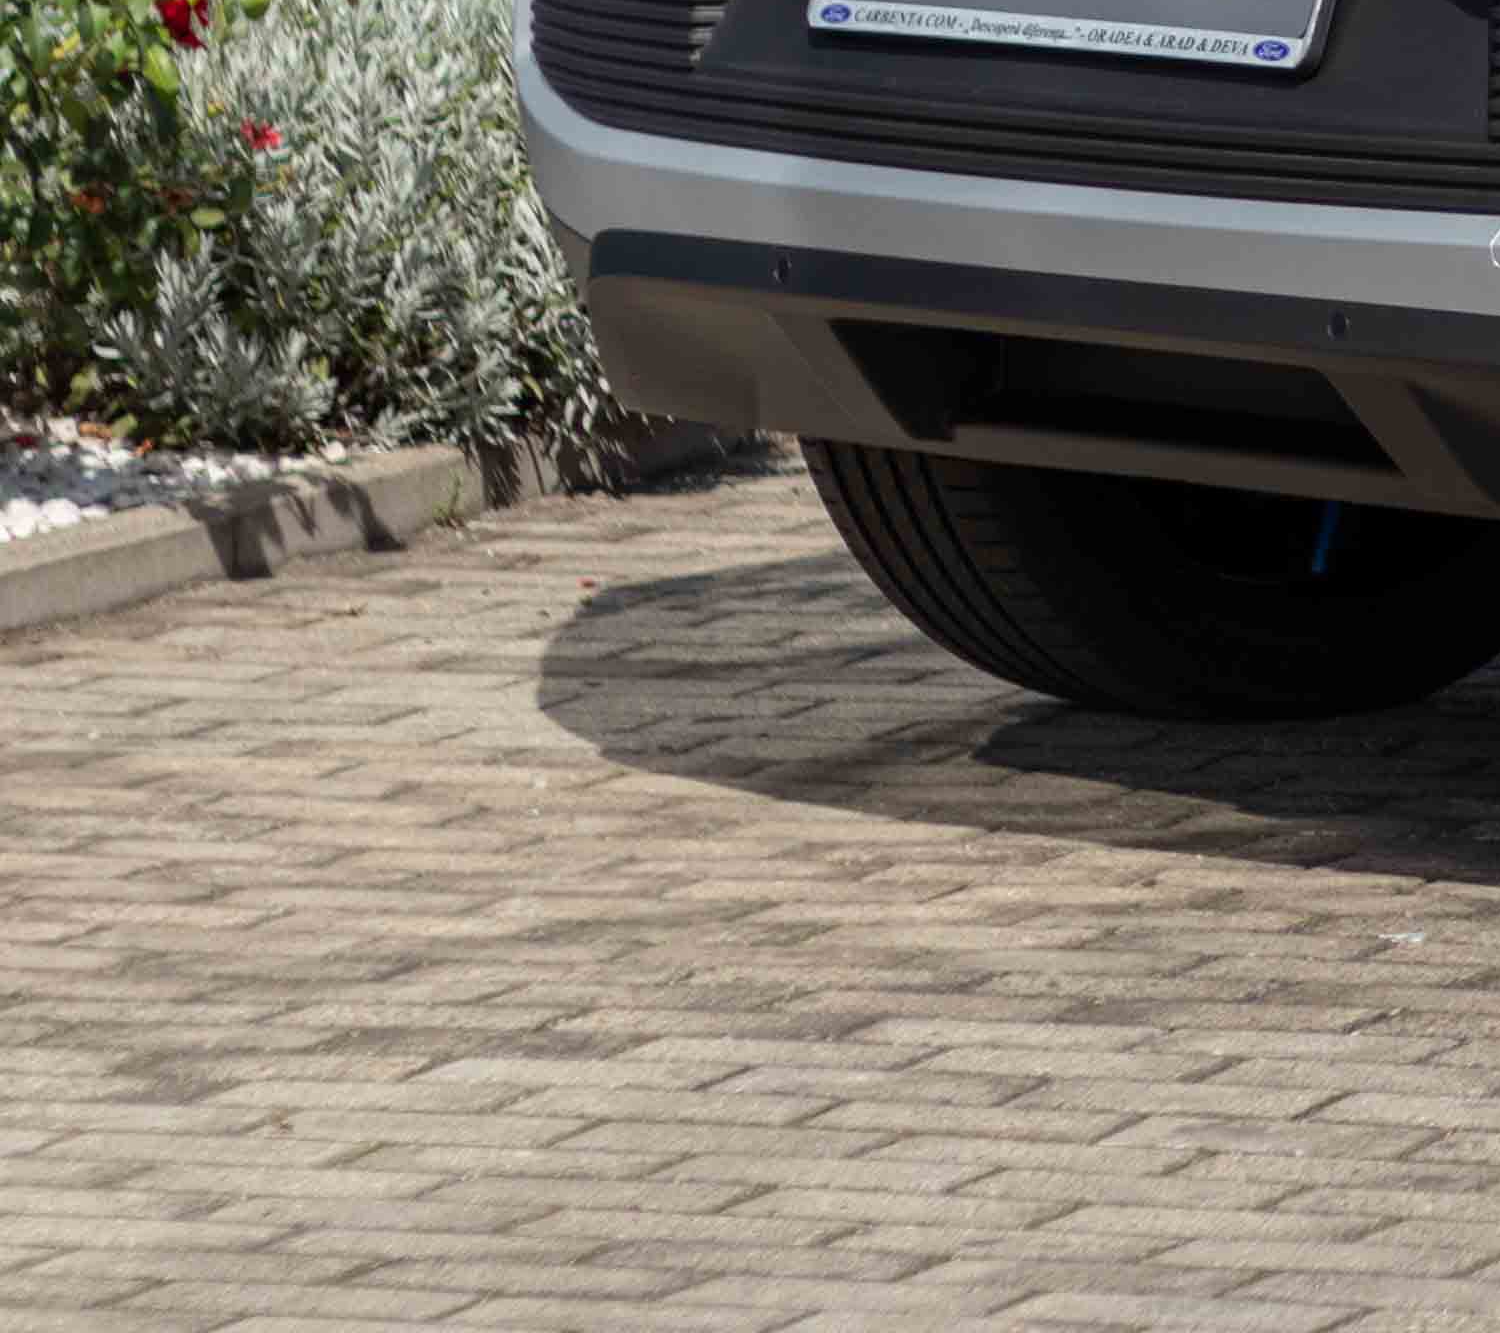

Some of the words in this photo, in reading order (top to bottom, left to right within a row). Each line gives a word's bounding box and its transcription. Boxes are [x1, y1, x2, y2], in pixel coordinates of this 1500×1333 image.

[854, 7, 923, 29] CARBENTA
[924, 13, 957, 31] COM
[1087, 28, 1142, 46] ORADEA
[1143, 34, 1153, 47] &
[1159, 34, 1196, 51] ARAD
[1196, 39, 1208, 53] &
[1208, 39, 1249, 56] DEVA
